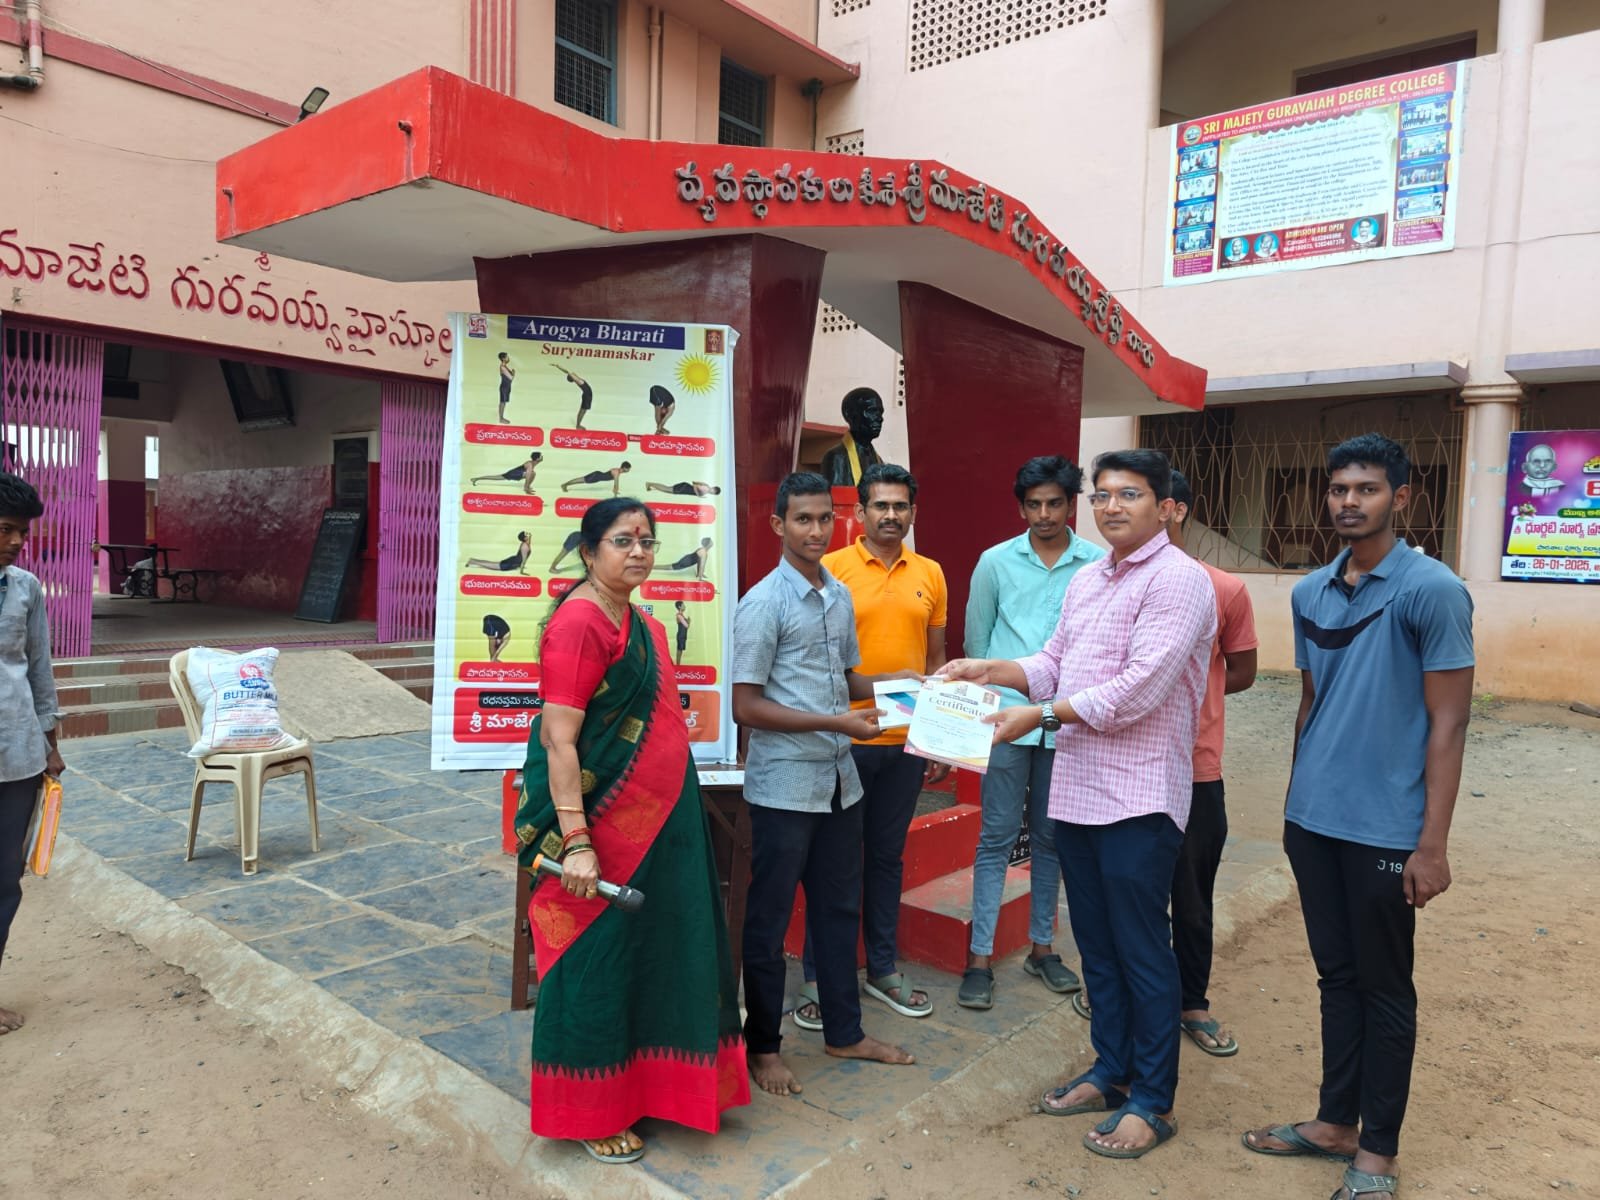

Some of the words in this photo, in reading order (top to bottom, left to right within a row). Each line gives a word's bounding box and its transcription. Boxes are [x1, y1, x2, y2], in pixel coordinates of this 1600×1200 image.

[1203, 120, 1220, 135] SRI
[1223, 110, 1264, 131] MAJETY
[1266, 95, 1335, 121] GURAVAIAH
[1339, 84, 1386, 106] DEGREE
[1389, 72, 1446, 93] COLLEGE
[900, 161, 928, 224] శ్రీ
[929, 168, 1005, 232] మాజేటి
[0, 228, 151, 299] మాజేటి
[171, 265, 342, 353] గురవయ్య
[523, 319, 590, 341] Arogya
[596, 324, 665, 344] Bharati
[541, 342, 656, 361] Suryanamaskar
[1560, 522, 1585, 539] సూర్య
[1533, 558, 1592, 572] 26-01-2025,
[465, 579, 532, 591] భుజంగాసనము
[223, 690, 263, 700] BUTTER
[929, 695, 986, 717] Certificate
[469, 711, 482, 732] శ్రీ
[486, 711, 534, 729] మాజే
